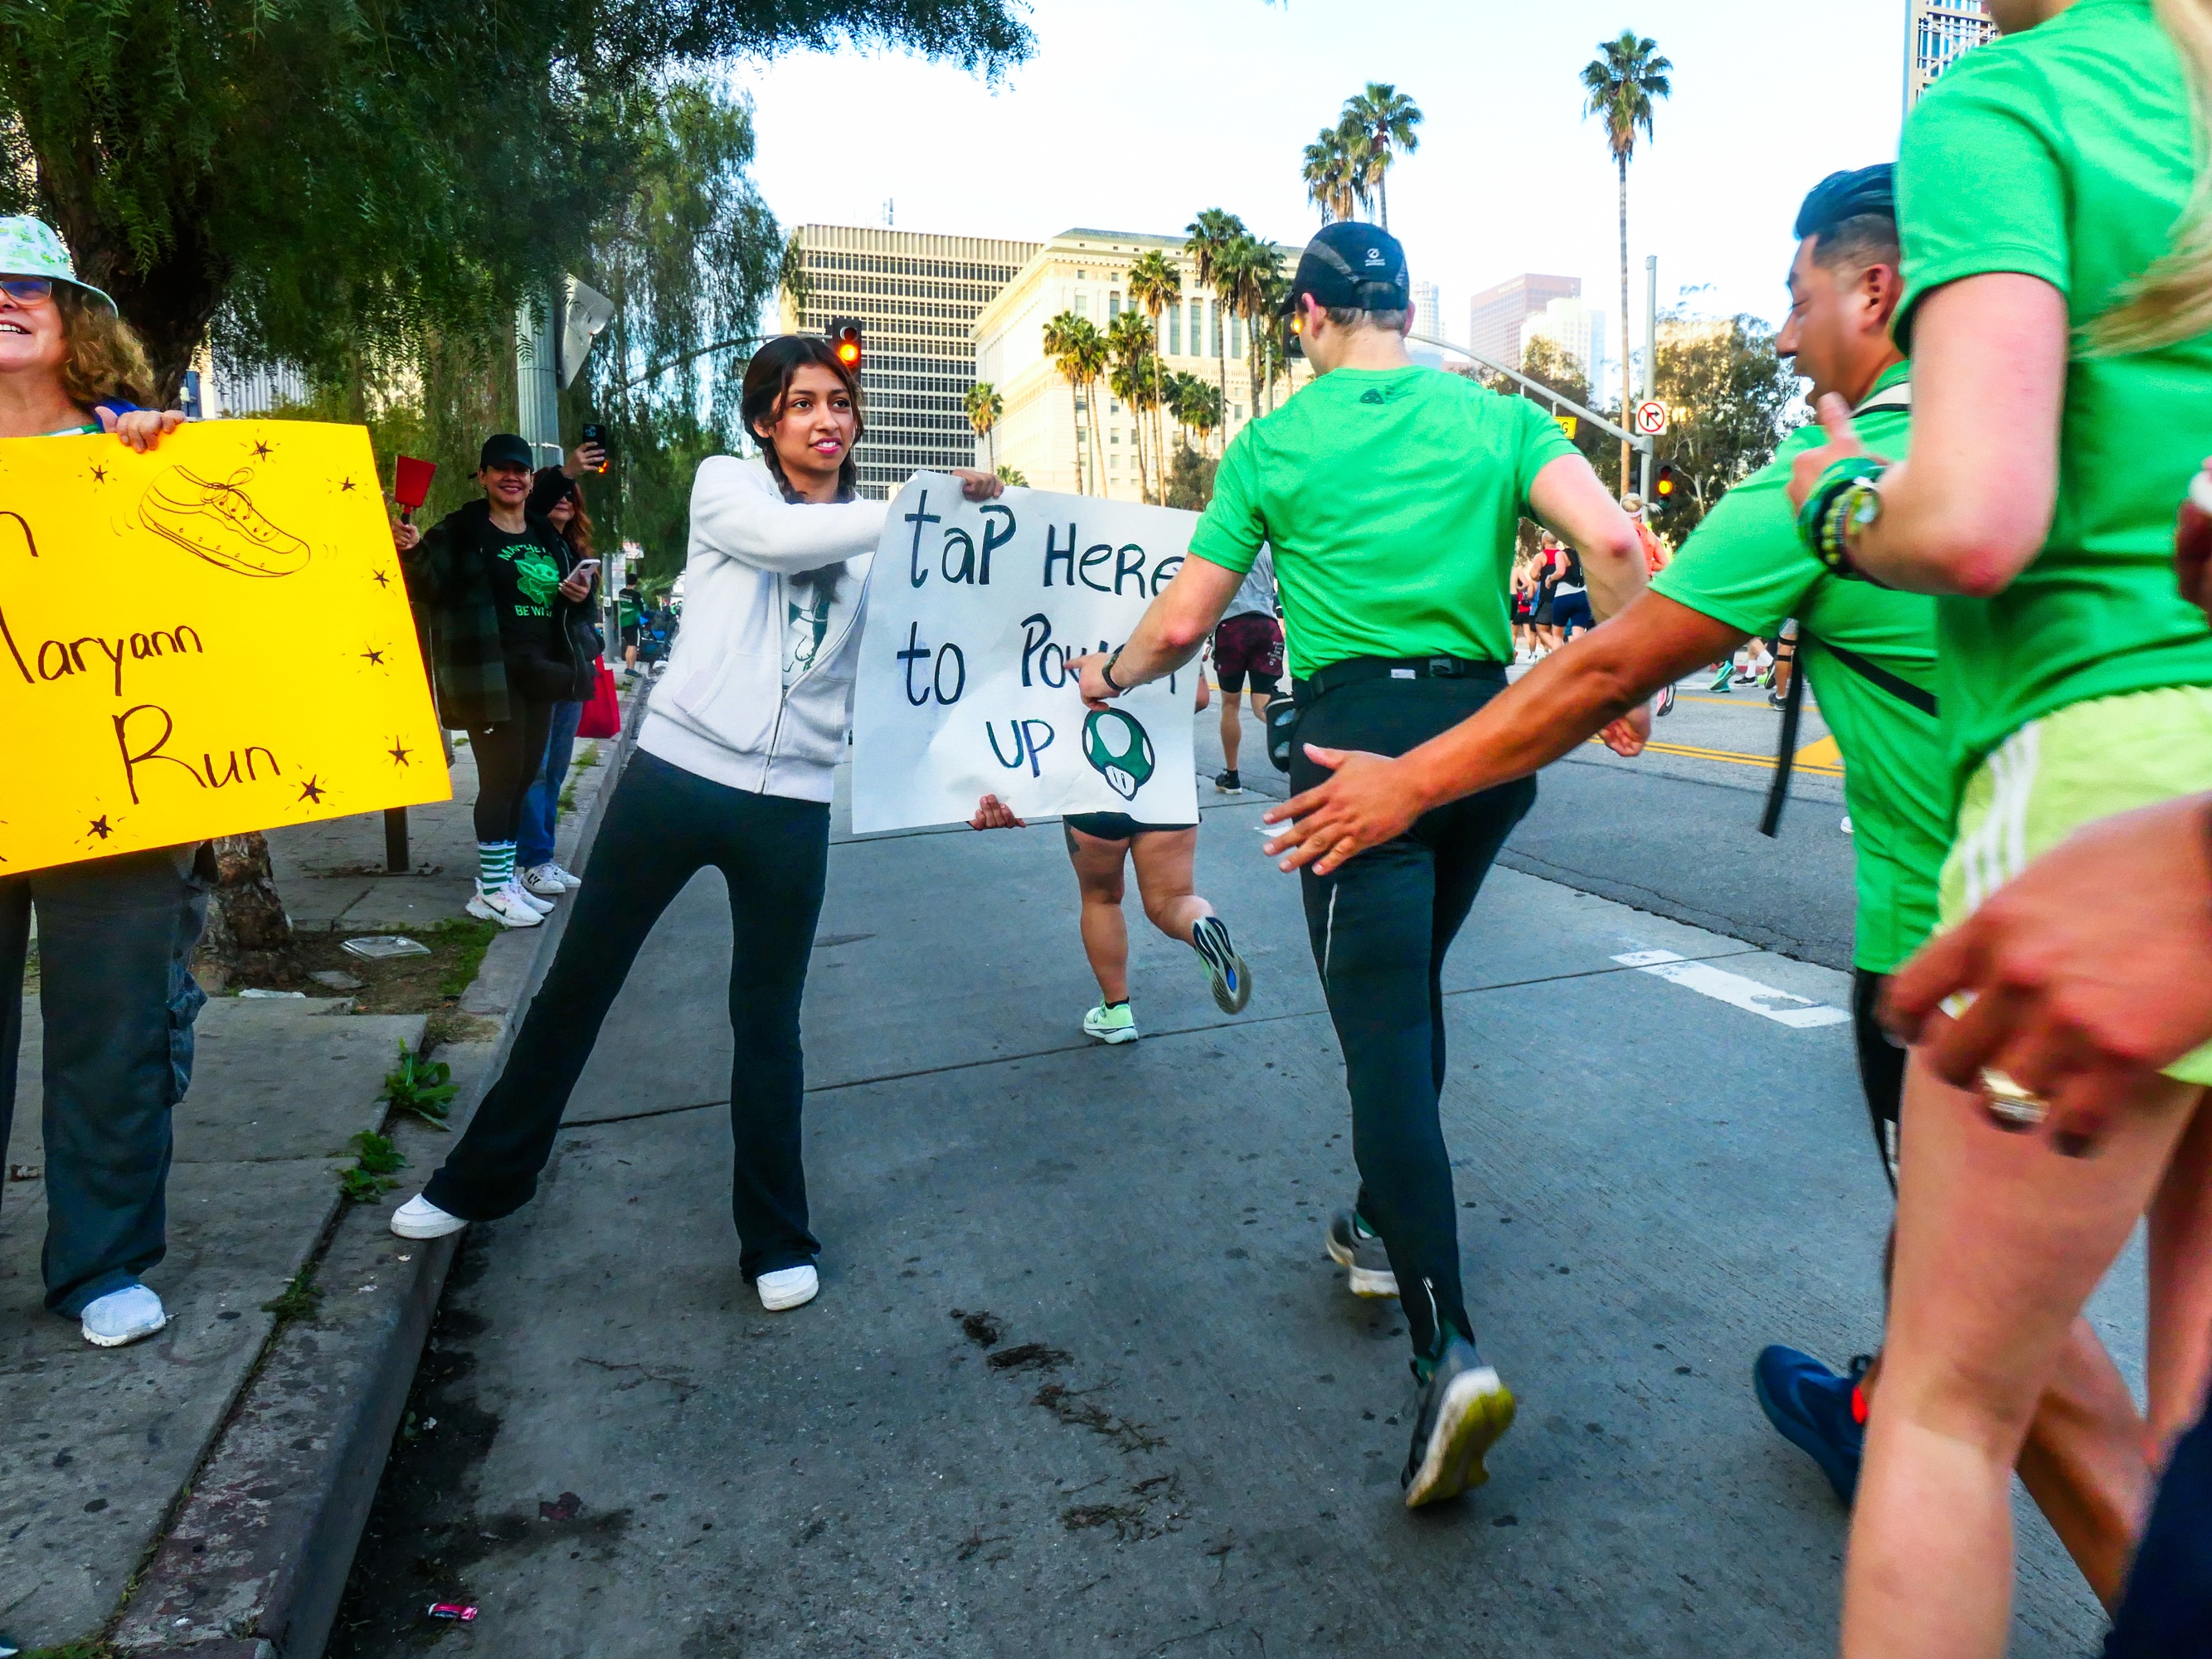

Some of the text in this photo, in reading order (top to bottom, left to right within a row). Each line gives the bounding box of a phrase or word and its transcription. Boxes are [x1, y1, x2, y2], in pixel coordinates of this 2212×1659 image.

[0, 606, 204, 697] aryann
[514, 606, 530, 616] BE
[897, 621, 966, 707] to
[111, 704, 281, 805] Run
[985, 719, 1055, 778] UP
